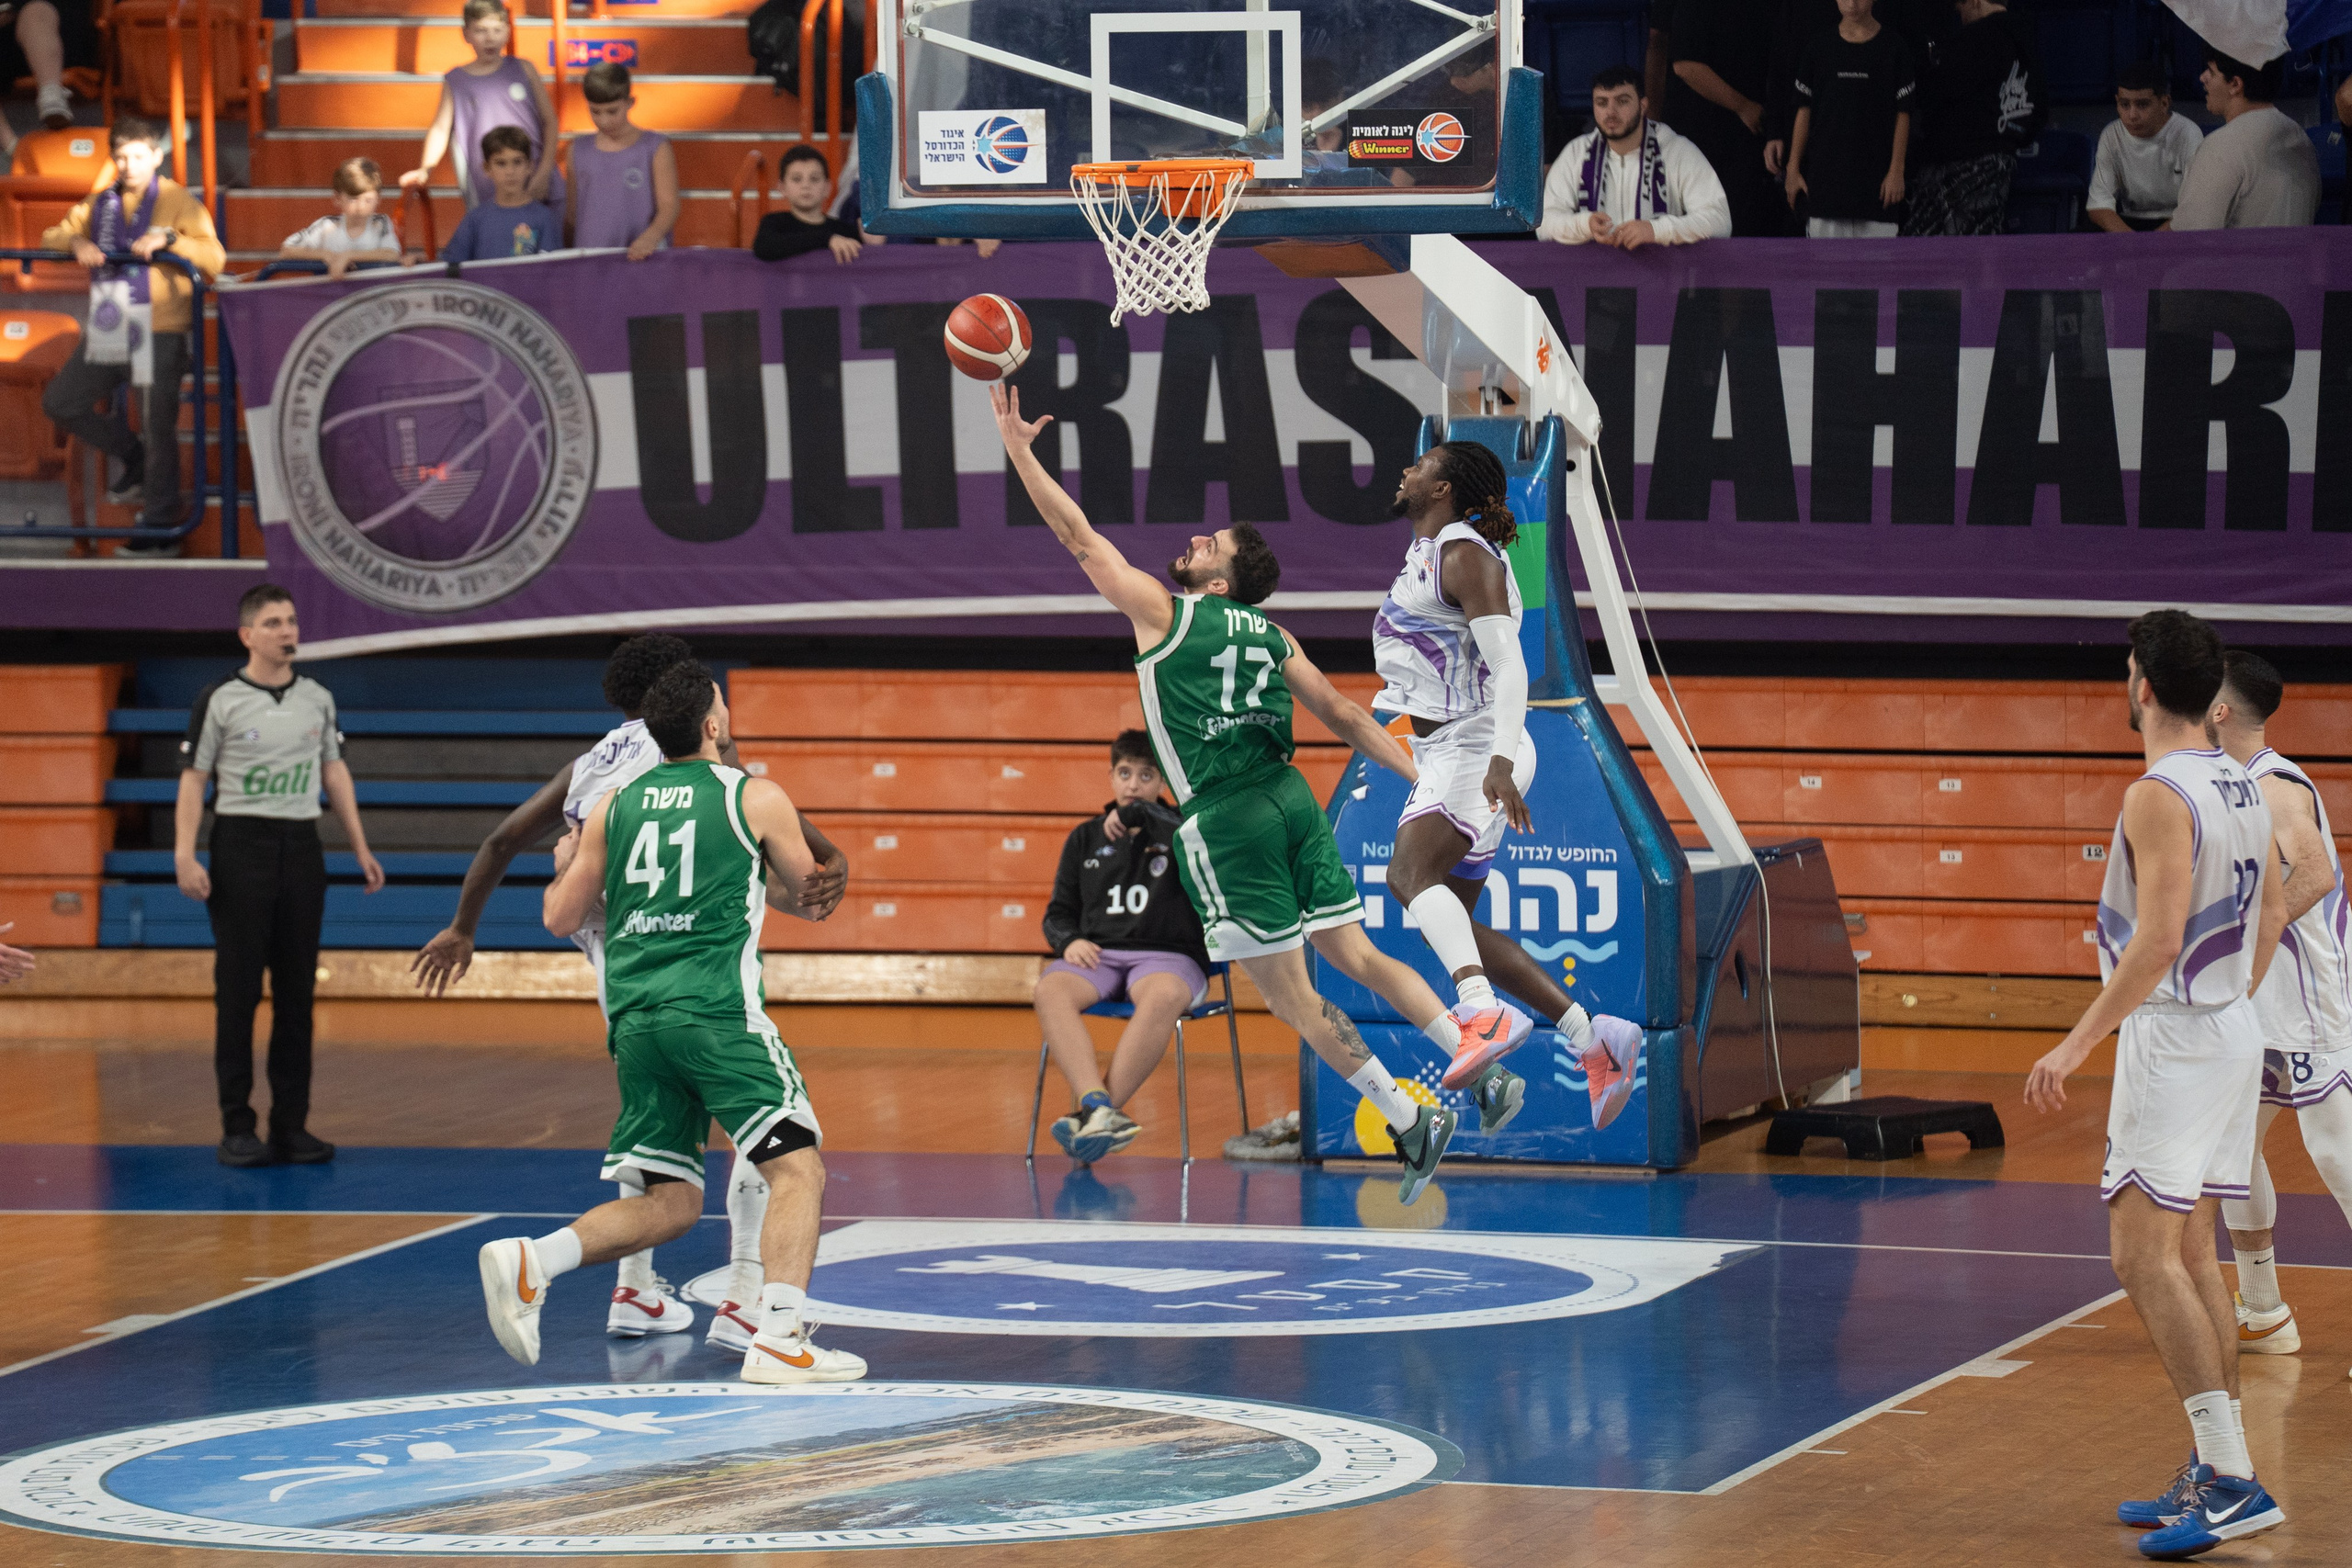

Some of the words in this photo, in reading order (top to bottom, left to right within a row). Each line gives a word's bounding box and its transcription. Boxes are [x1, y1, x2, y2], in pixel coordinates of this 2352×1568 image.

[940, 129, 965, 139] איגוד
[1352, 125, 1389, 137] לאומית
[1391, 124, 1414, 137] ליגה
[924, 140, 965, 151] הכדורסל
[1362, 141, 1410, 155] Winner
[924, 152, 966, 163] הישראלי
[432, 294, 505, 327] IRONI
[507, 321, 585, 446] NAHARIYA
[628, 288, 1424, 545] ULTRAS
[323, 524, 443, 598] NAHARIYA
[1224, 607, 1268, 637] שרון
[1210, 645, 1276, 713] 17
[243, 757, 314, 795] Gali
[642, 785, 694, 809] משה
[625, 819, 696, 898] 41
[1508, 843, 1553, 862] לגדול
[1557, 844, 1617, 863] החופש
[2086, 847, 2103, 858] 12
[1105, 884, 1149, 915] 10
[628, 909, 695, 934] Hunter
[1012, 1390, 1122, 1403] הים
[1128, 1399, 1290, 1421] שכונת
[410, 1413, 537, 1435] שכונת
[331, 1434, 422, 1449] הים
